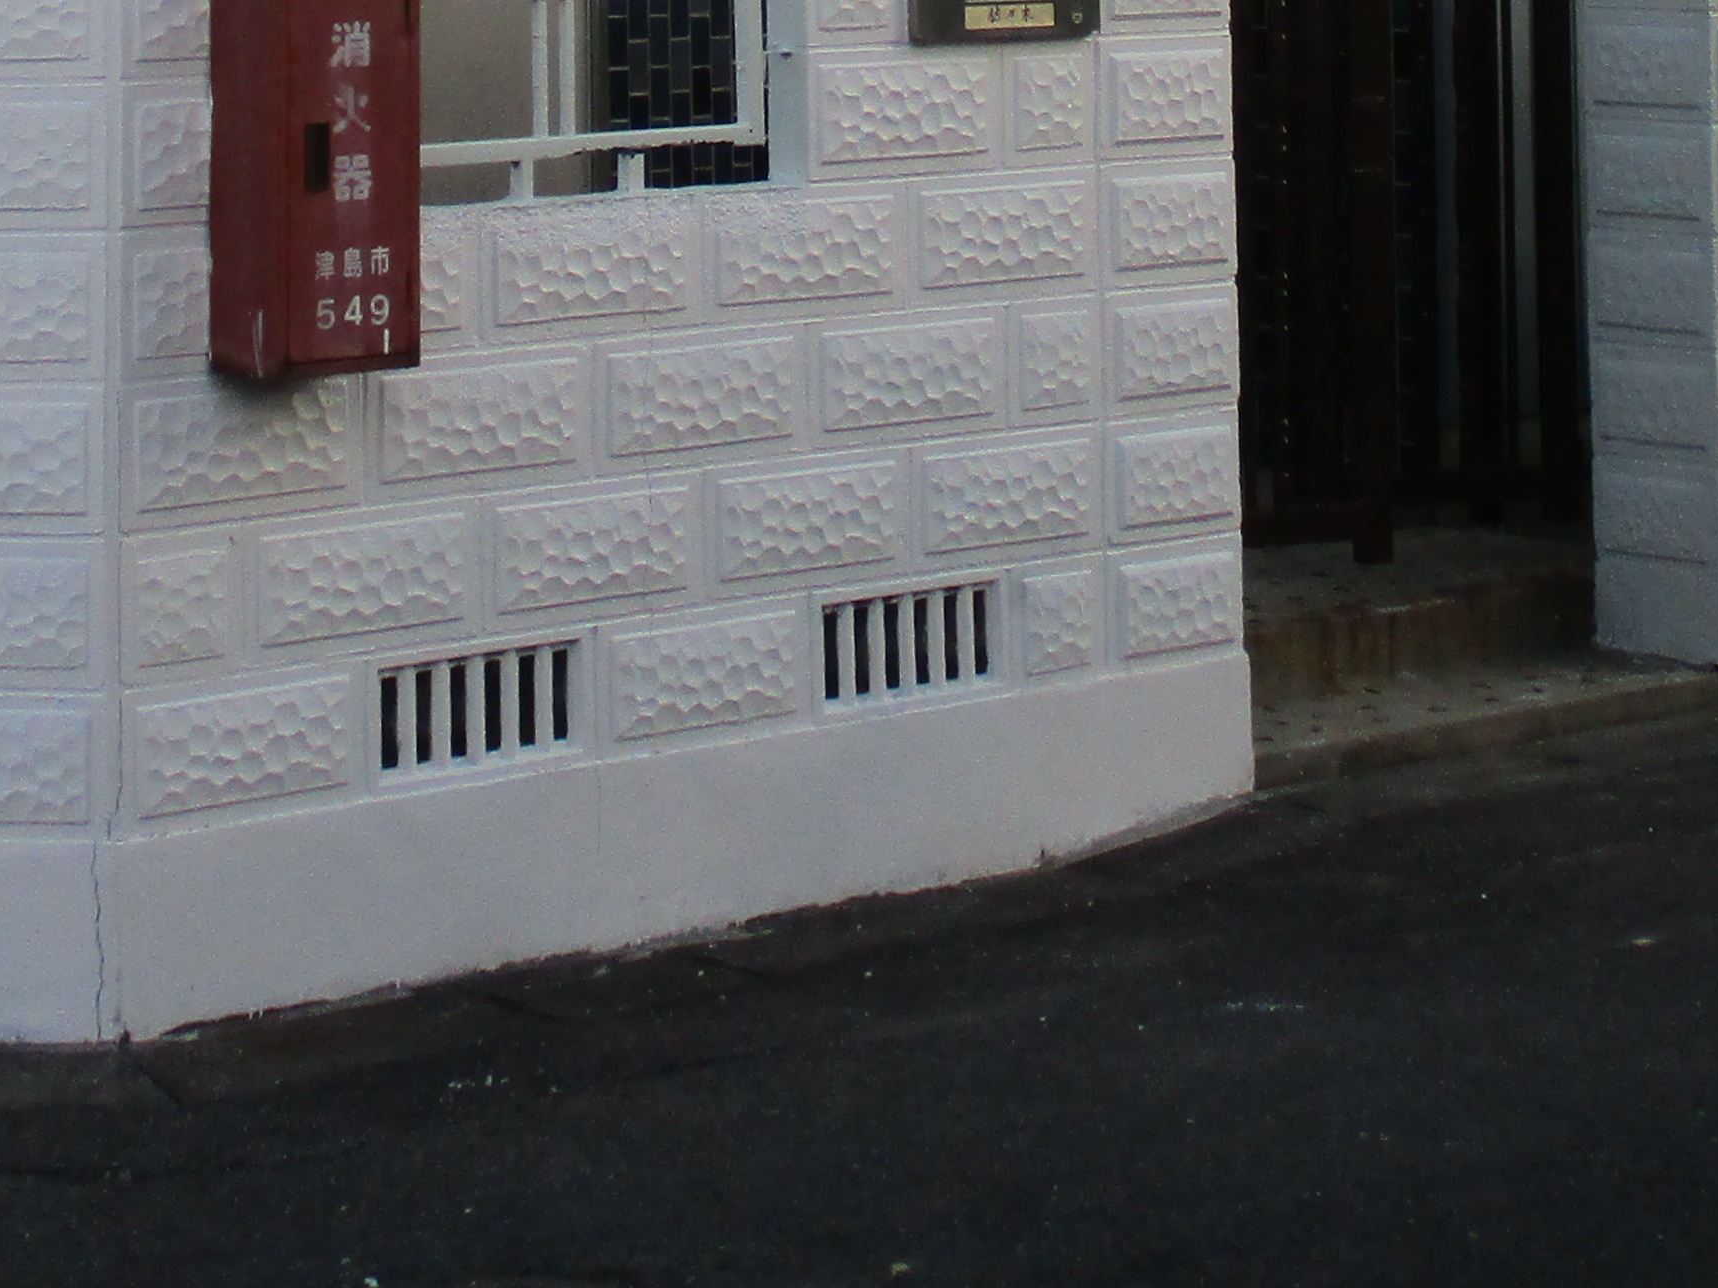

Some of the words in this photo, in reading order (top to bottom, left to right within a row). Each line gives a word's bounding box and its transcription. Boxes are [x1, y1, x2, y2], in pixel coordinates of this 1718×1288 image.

[328, 19, 374, 204] 消火器
[314, 245, 390, 281] 津島市
[316, 293, 390, 331] 549
